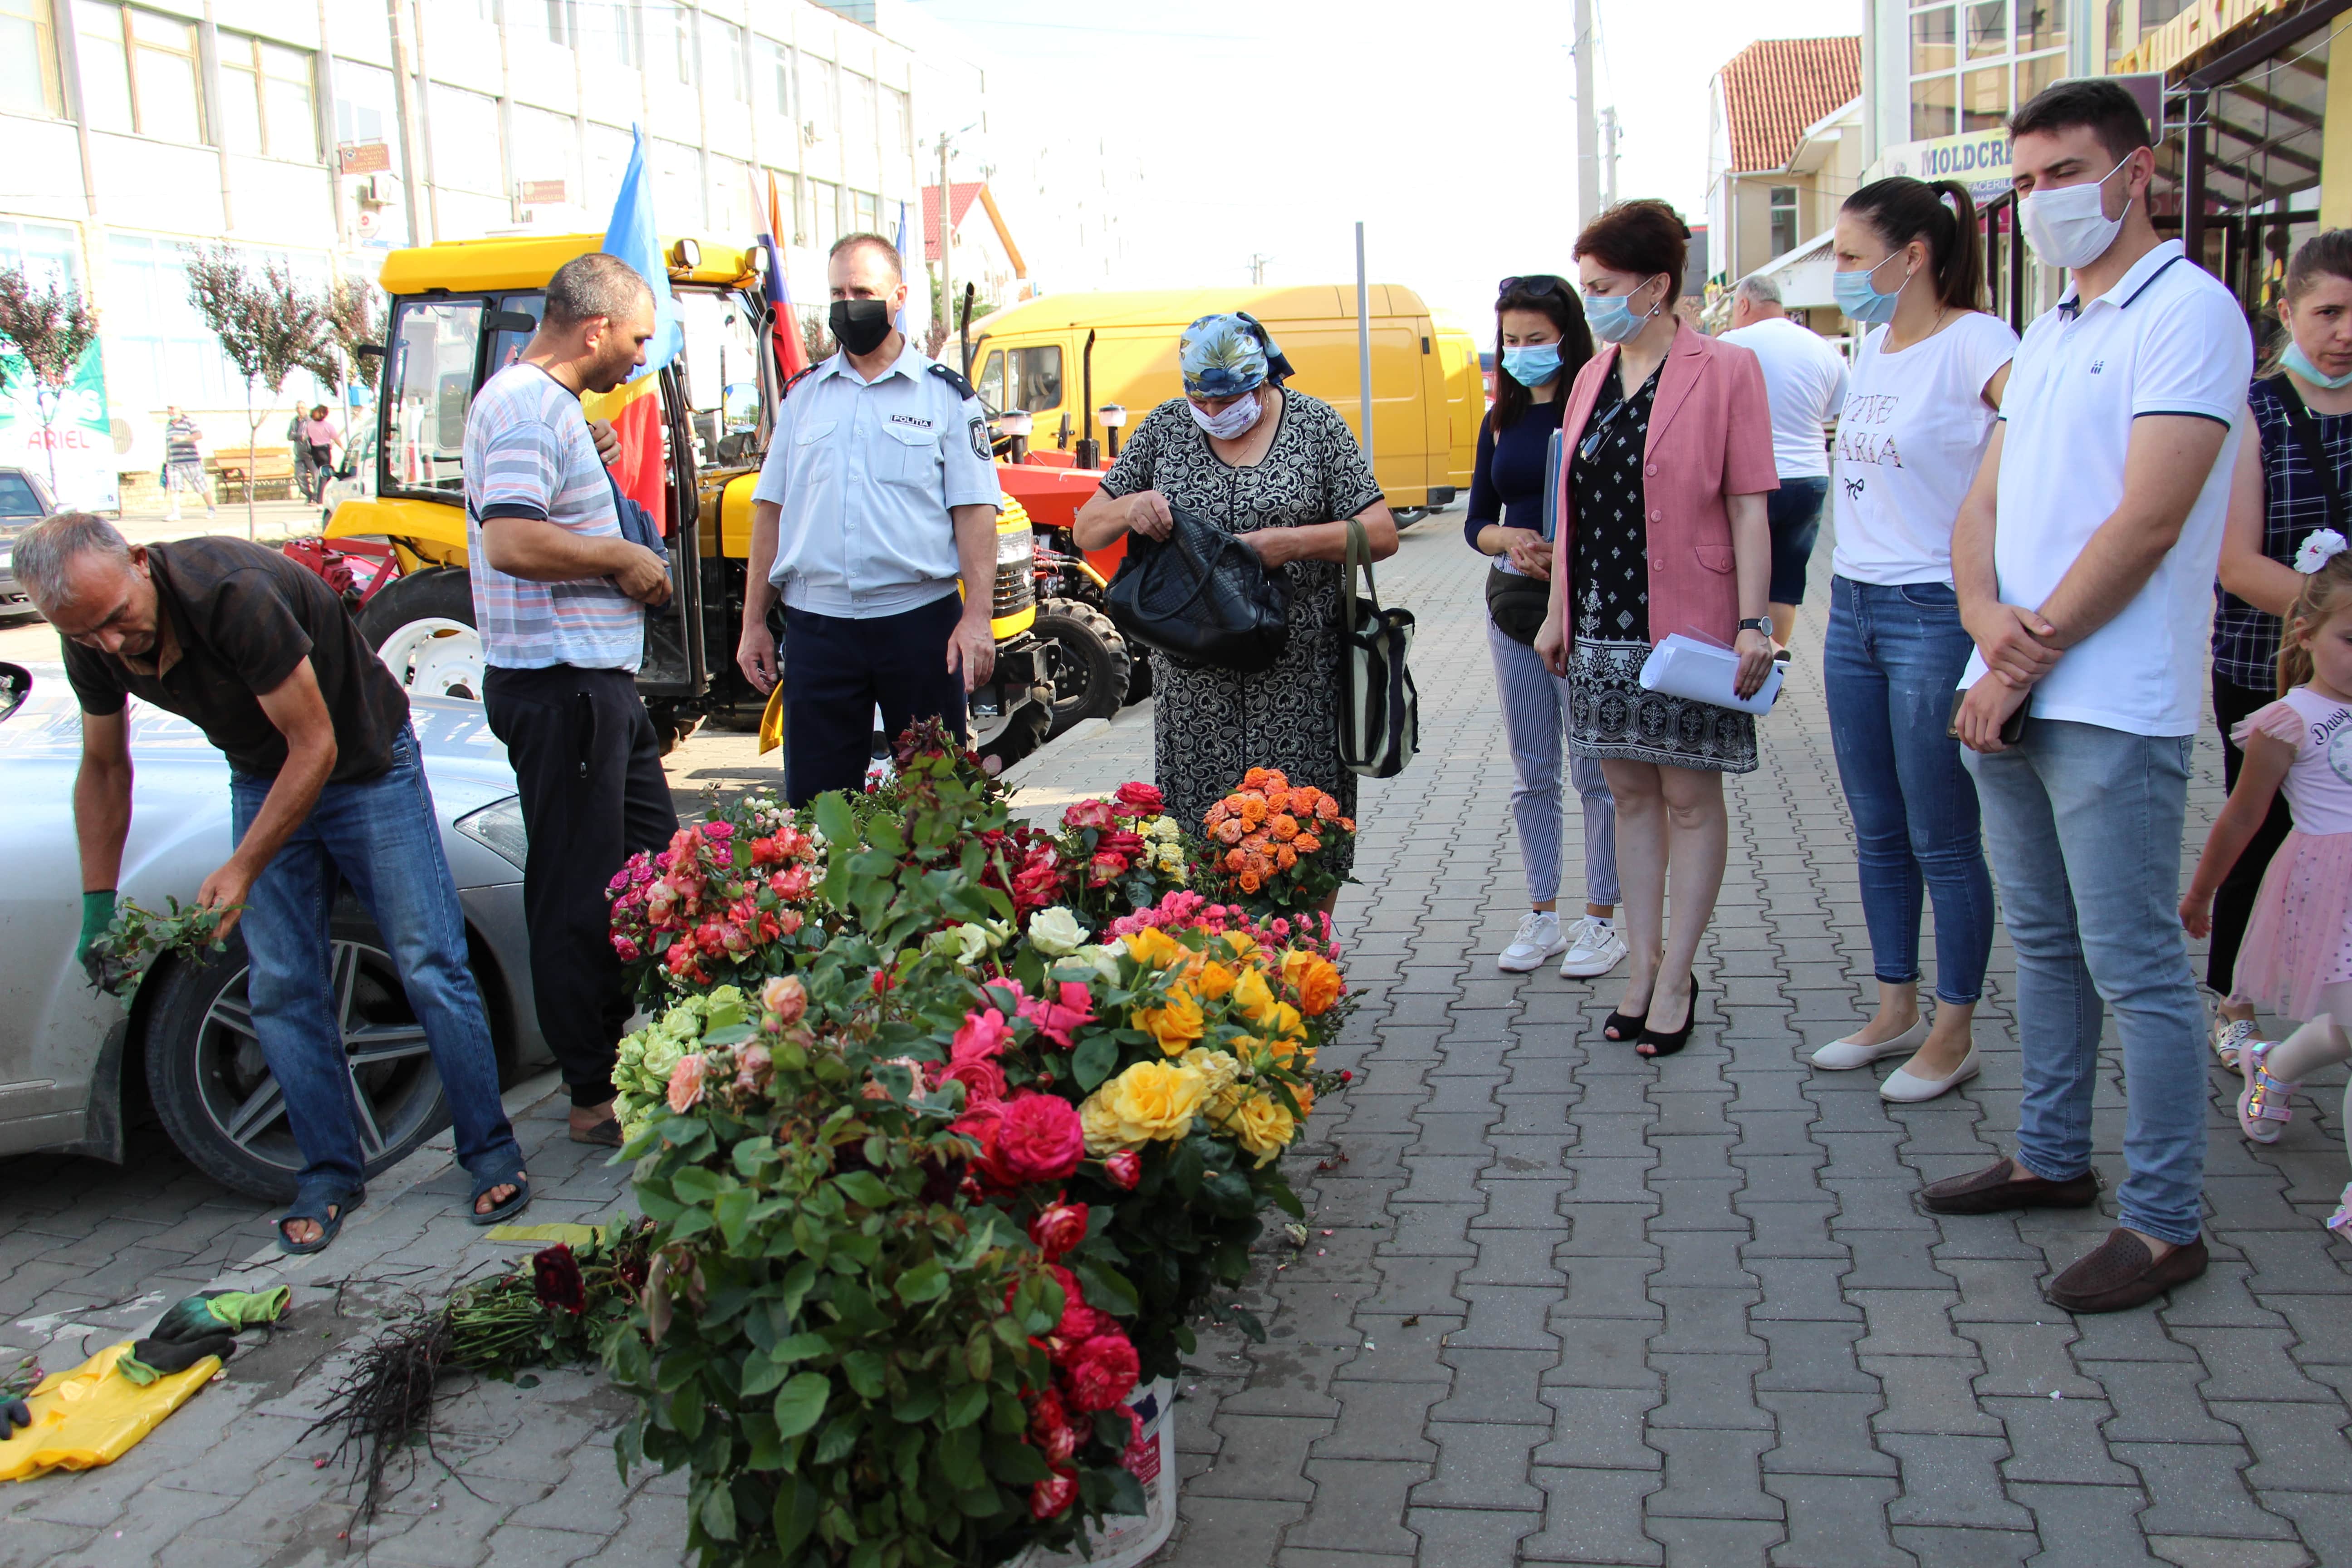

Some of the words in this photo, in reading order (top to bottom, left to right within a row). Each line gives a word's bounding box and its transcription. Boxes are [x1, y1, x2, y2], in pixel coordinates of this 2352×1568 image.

[1840, 392, 1900, 424] VIVE
[27, 430, 91, 450] ARIEL
[2310, 708, 2352, 745] Daisy
